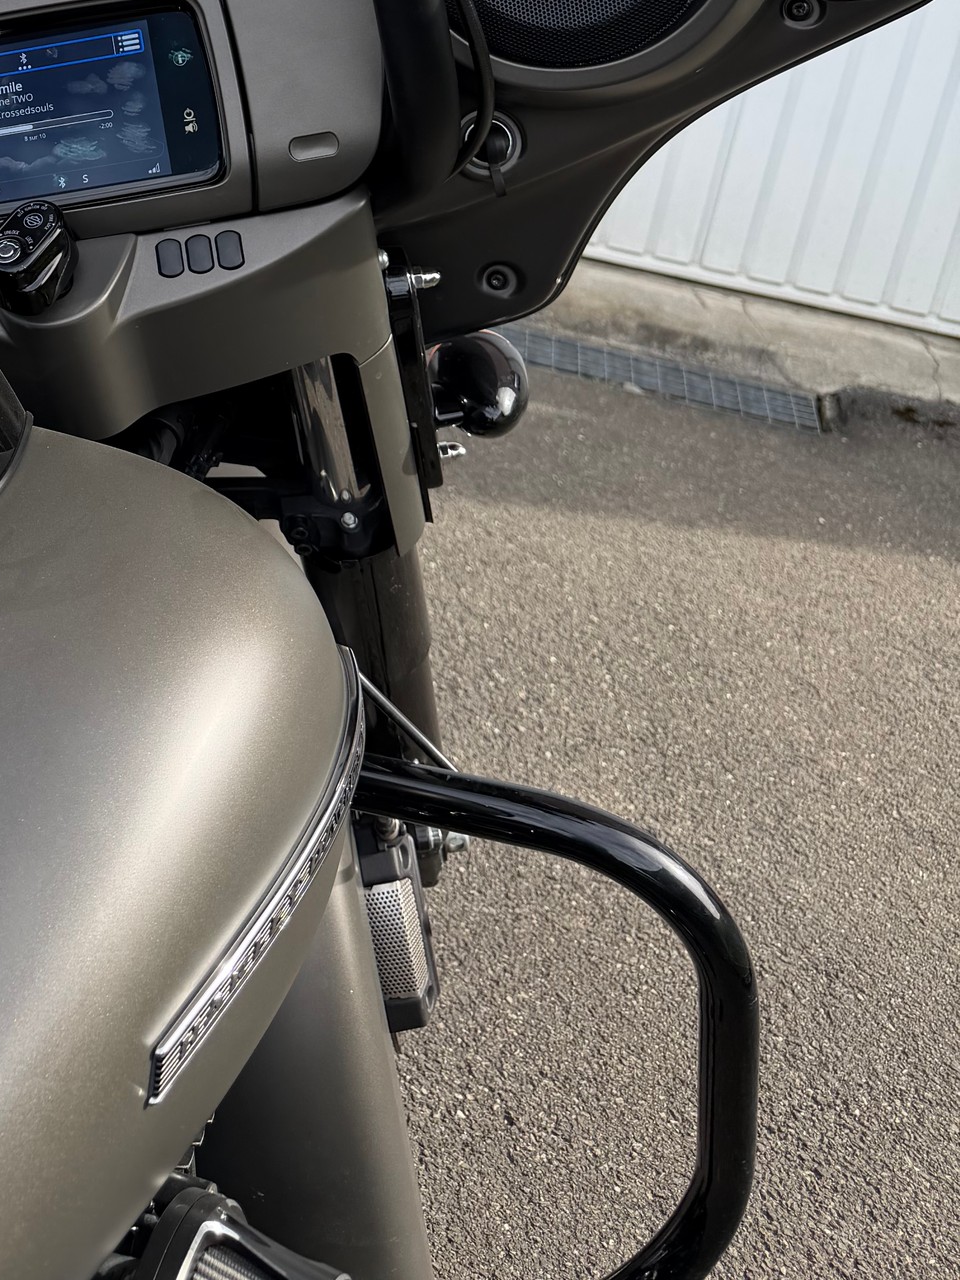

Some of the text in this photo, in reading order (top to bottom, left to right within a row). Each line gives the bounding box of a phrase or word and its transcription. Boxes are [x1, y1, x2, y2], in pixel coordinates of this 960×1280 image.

[11, 93, 34, 105] TWO
[98, 121, 113, 130] -2:00
[82, 174, 89, 184] S
